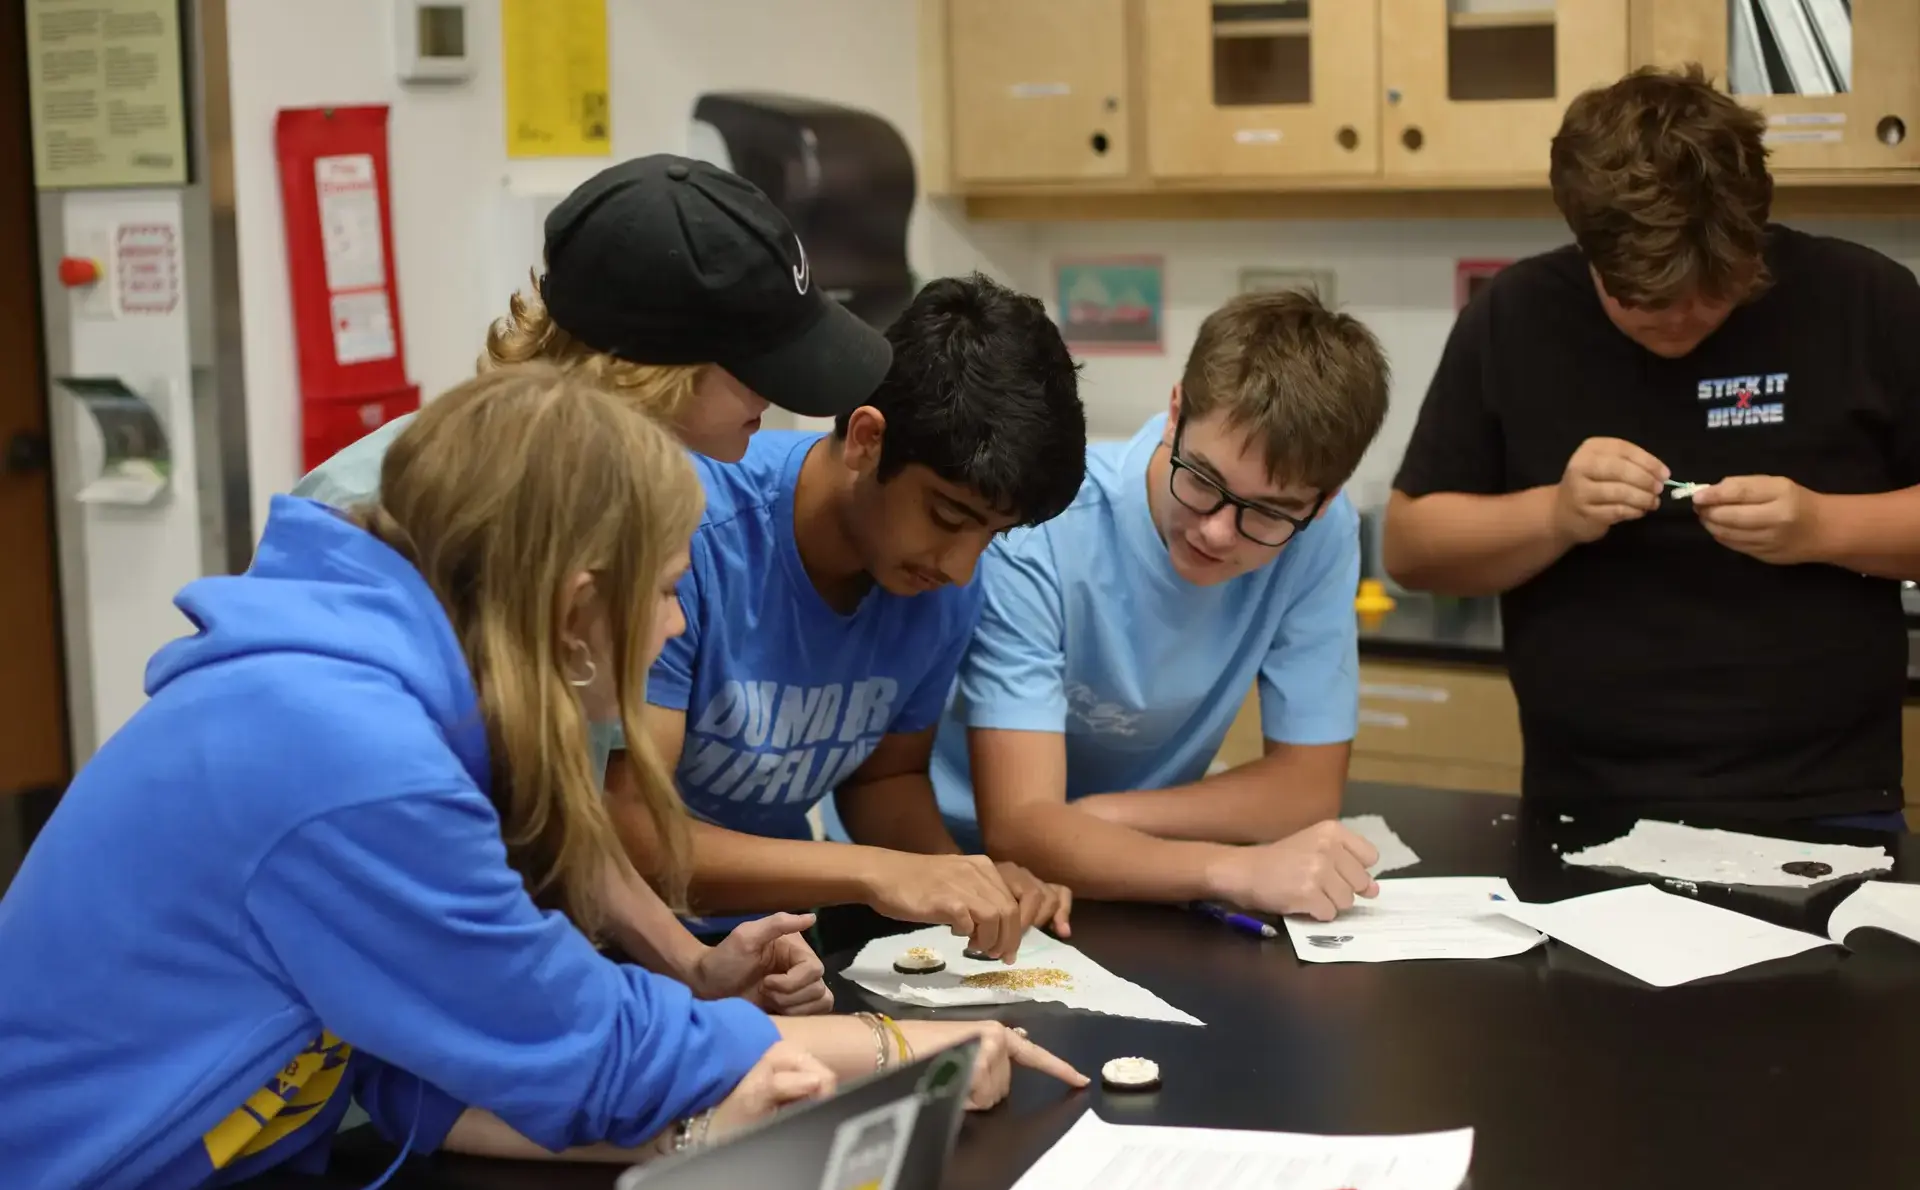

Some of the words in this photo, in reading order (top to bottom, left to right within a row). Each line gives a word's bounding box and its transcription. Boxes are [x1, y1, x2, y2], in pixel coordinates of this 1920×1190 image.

[1698, 376, 1761, 399] STICK
[1765, 373, 1788, 393] IT
[1707, 403, 1784, 427] DIVINE
